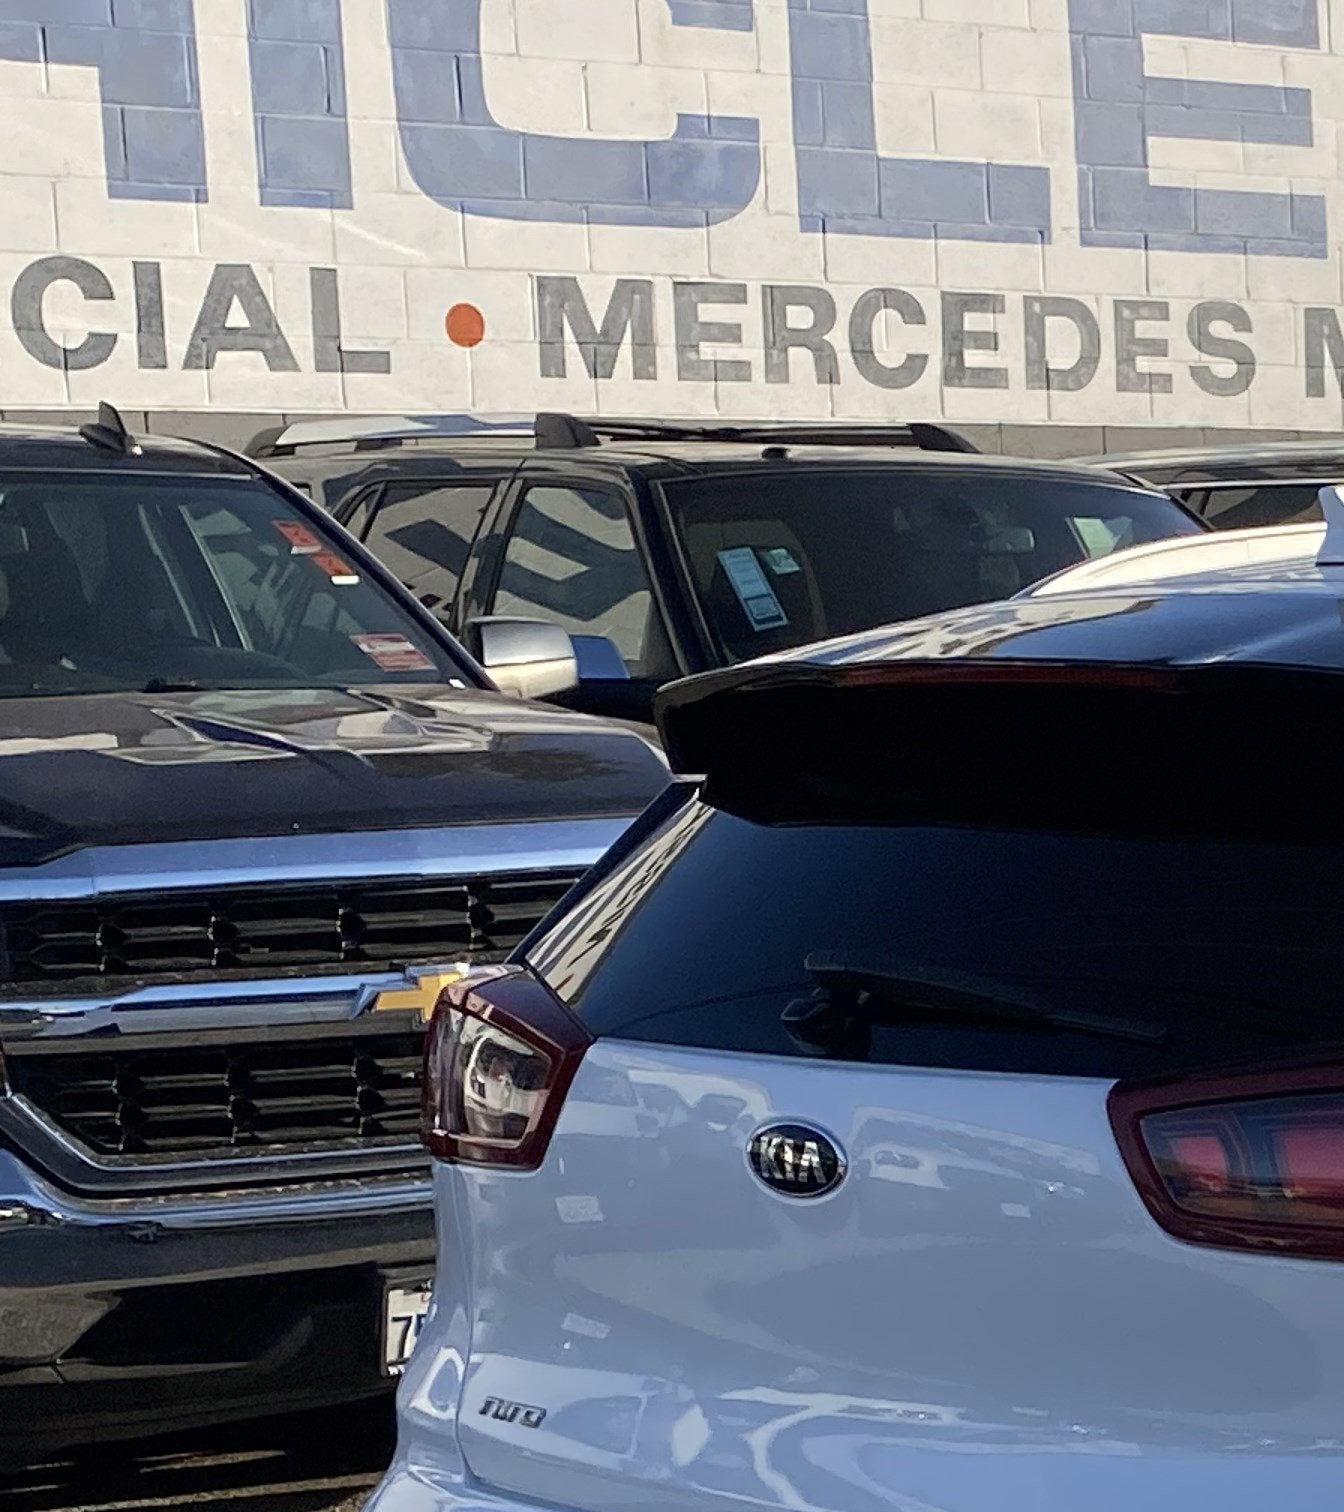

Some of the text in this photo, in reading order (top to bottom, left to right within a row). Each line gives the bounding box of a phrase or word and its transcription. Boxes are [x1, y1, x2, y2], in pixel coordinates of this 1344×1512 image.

[11, 256, 391, 374] CIAL
[537, 275, 1257, 398] MERCEDES
[761, 1136, 827, 1184] KIA
